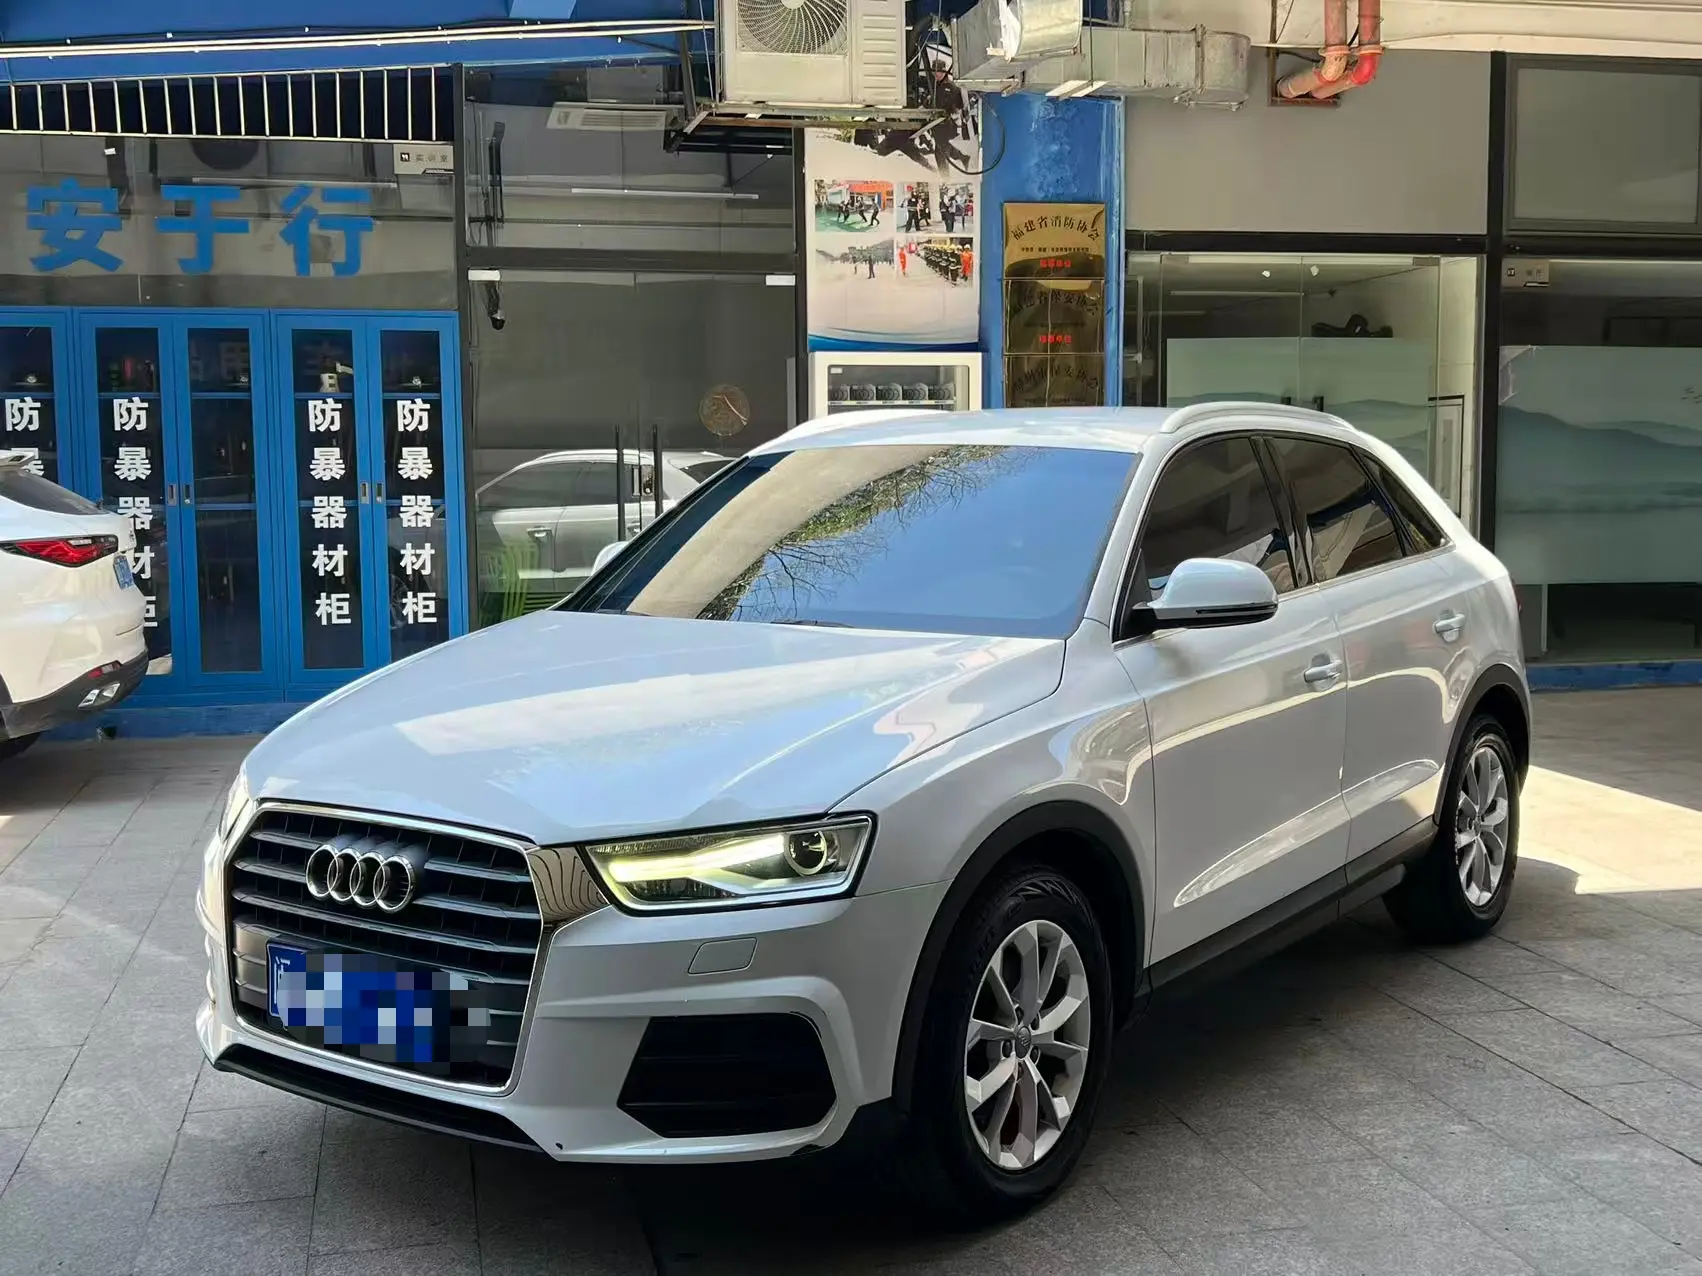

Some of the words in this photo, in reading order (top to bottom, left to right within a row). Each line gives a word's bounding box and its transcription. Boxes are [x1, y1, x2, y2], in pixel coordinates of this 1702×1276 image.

[26, 177, 375, 277] 安于行
[1011, 215, 1100, 242] 福建省消防协会
[308, 398, 351, 625] 防暴器材柜
[397, 398, 437, 624] 防暴器材柜
